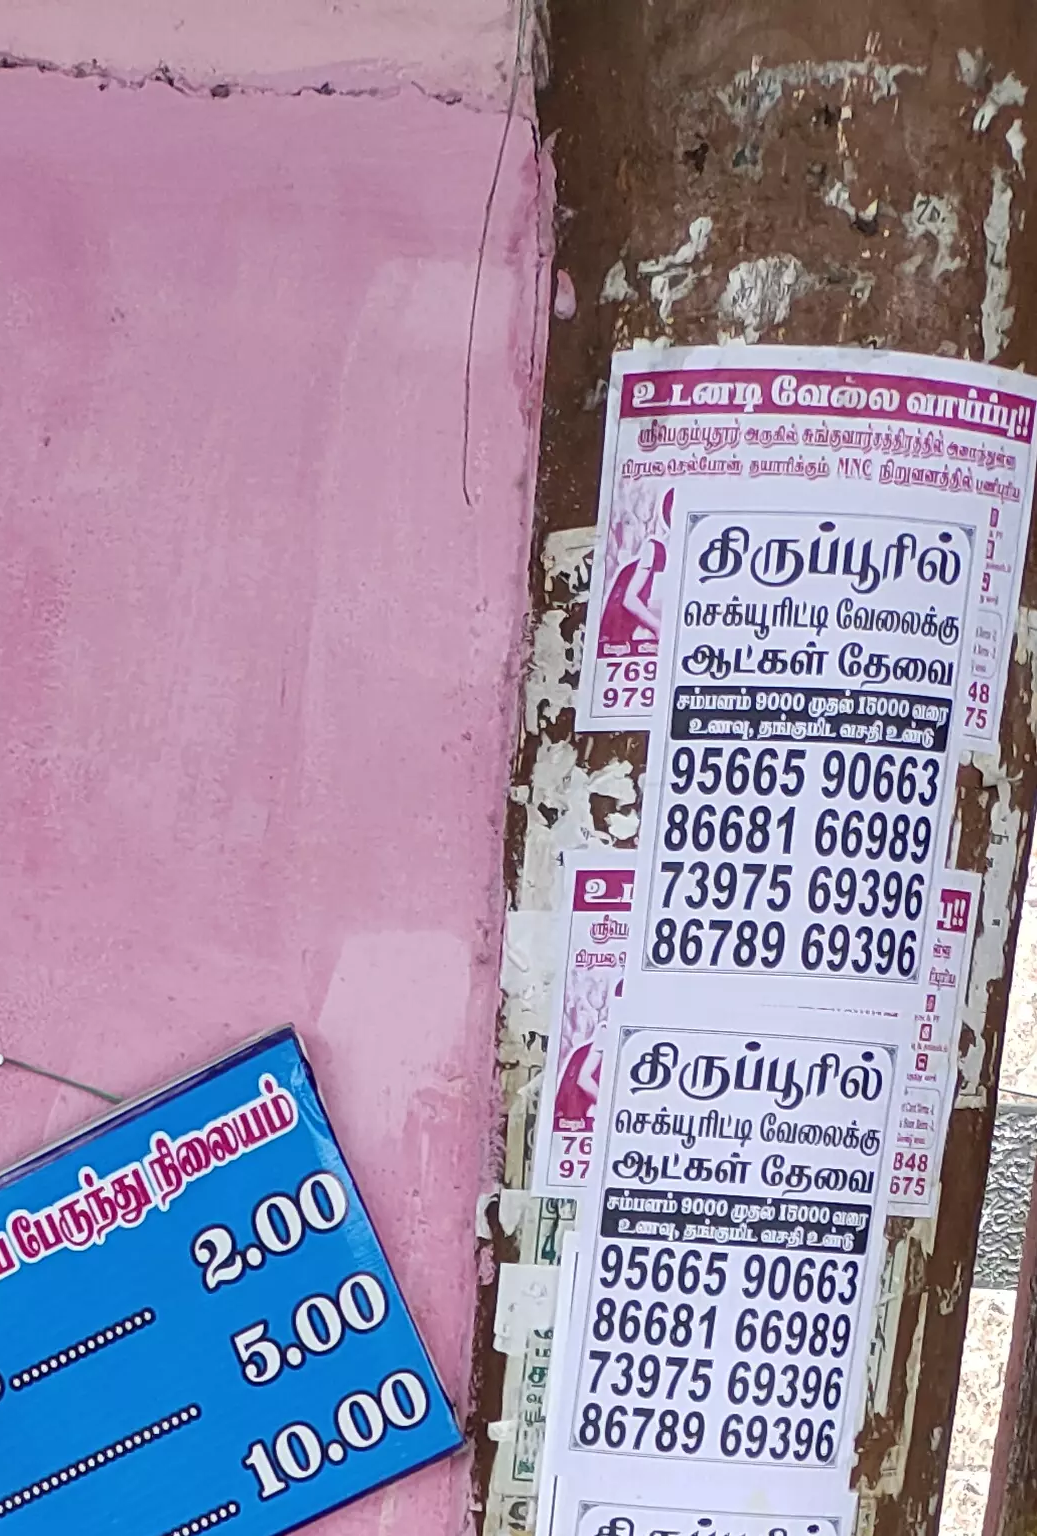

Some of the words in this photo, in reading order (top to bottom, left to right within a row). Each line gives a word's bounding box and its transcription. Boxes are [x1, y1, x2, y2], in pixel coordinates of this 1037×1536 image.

[632, 380, 763, 413] உடனடி
[771, 375, 900, 412] வேலை
[838, 457, 873, 478] MNC
[697, 521, 962, 595] திருப்பூரில்
[683, 596, 830, 640] செக்யூரிட்டி
[835, 597, 961, 645] வேலைக்கு
[681, 642, 830, 682] ஆட்கள்
[837, 643, 953, 688] தேவை
[755, 692, 806, 712] 9000
[808, 690, 855, 718] முதல்
[858, 695, 910, 716] 15000
[839, 719, 884, 744] வசதி
[669, 746, 808, 799] 95665
[819, 748, 941, 808] 90663
[662, 803, 799, 856] 86681
[813, 807, 933, 864] 66989
[659, 861, 794, 912] 73975
[806, 864, 927, 922] 69396
[650, 917, 787, 970] 86789
[799, 921, 918, 979] 69396
[629, 1040, 884, 1111] திருப்பூரில்
[614, 1106, 753, 1148] செக்யூரிட்டி
[760, 1111, 882, 1156] வேலைக்கு
[13, 1163, 150, 1260] பேருந்து
[149, 1080, 297, 1205] நிலையம்
[611, 1150, 753, 1187] ஆட்கள்
[760, 1154, 874, 1197] தேவை
[193, 1171, 349, 1289] 2.00
[681, 1197, 729, 1217] 9000
[731, 1197, 776, 1223] முதல்
[779, 1204, 830, 1224] 15000
[760, 1224, 806, 1249] வசதி
[599, 1244, 729, 1297] 95665
[743, 1253, 860, 1306] 90663
[233, 1273, 386, 1383] 5.00
[592, 1298, 718, 1350] 86681
[734, 1307, 852, 1359] 66989
[588, 1350, 713, 1402] 73975
[727, 1360, 844, 1411] 69396
[244, 1371, 427, 1498] 10.00
[579, 1402, 705, 1454] 86789
[720, 1413, 835, 1464] 69396
